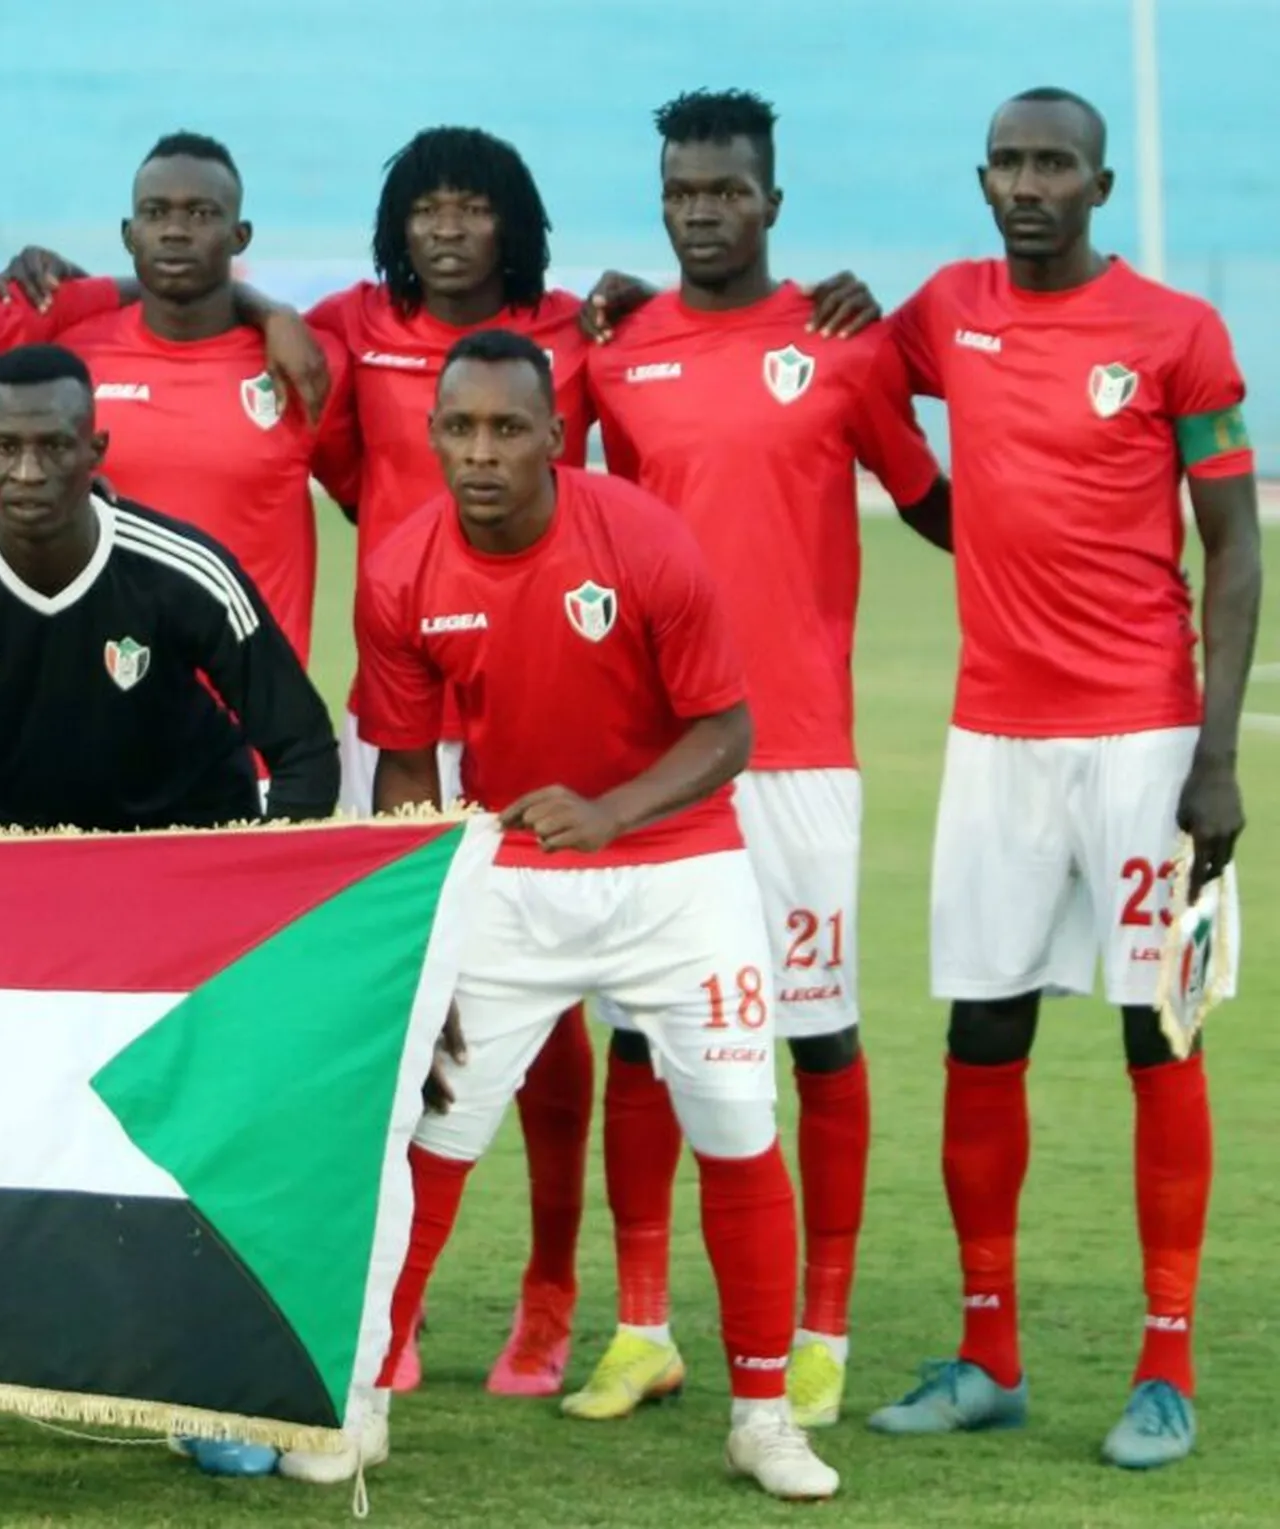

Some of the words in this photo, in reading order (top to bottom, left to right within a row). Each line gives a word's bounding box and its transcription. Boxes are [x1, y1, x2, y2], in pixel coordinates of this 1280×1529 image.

[627, 362, 681, 383] LEGEA
[422, 613, 488, 634] LEGEA
[783, 909, 843, 969] 21
[700, 966, 767, 1030] 18
[779, 984, 842, 1003] LEGEA
